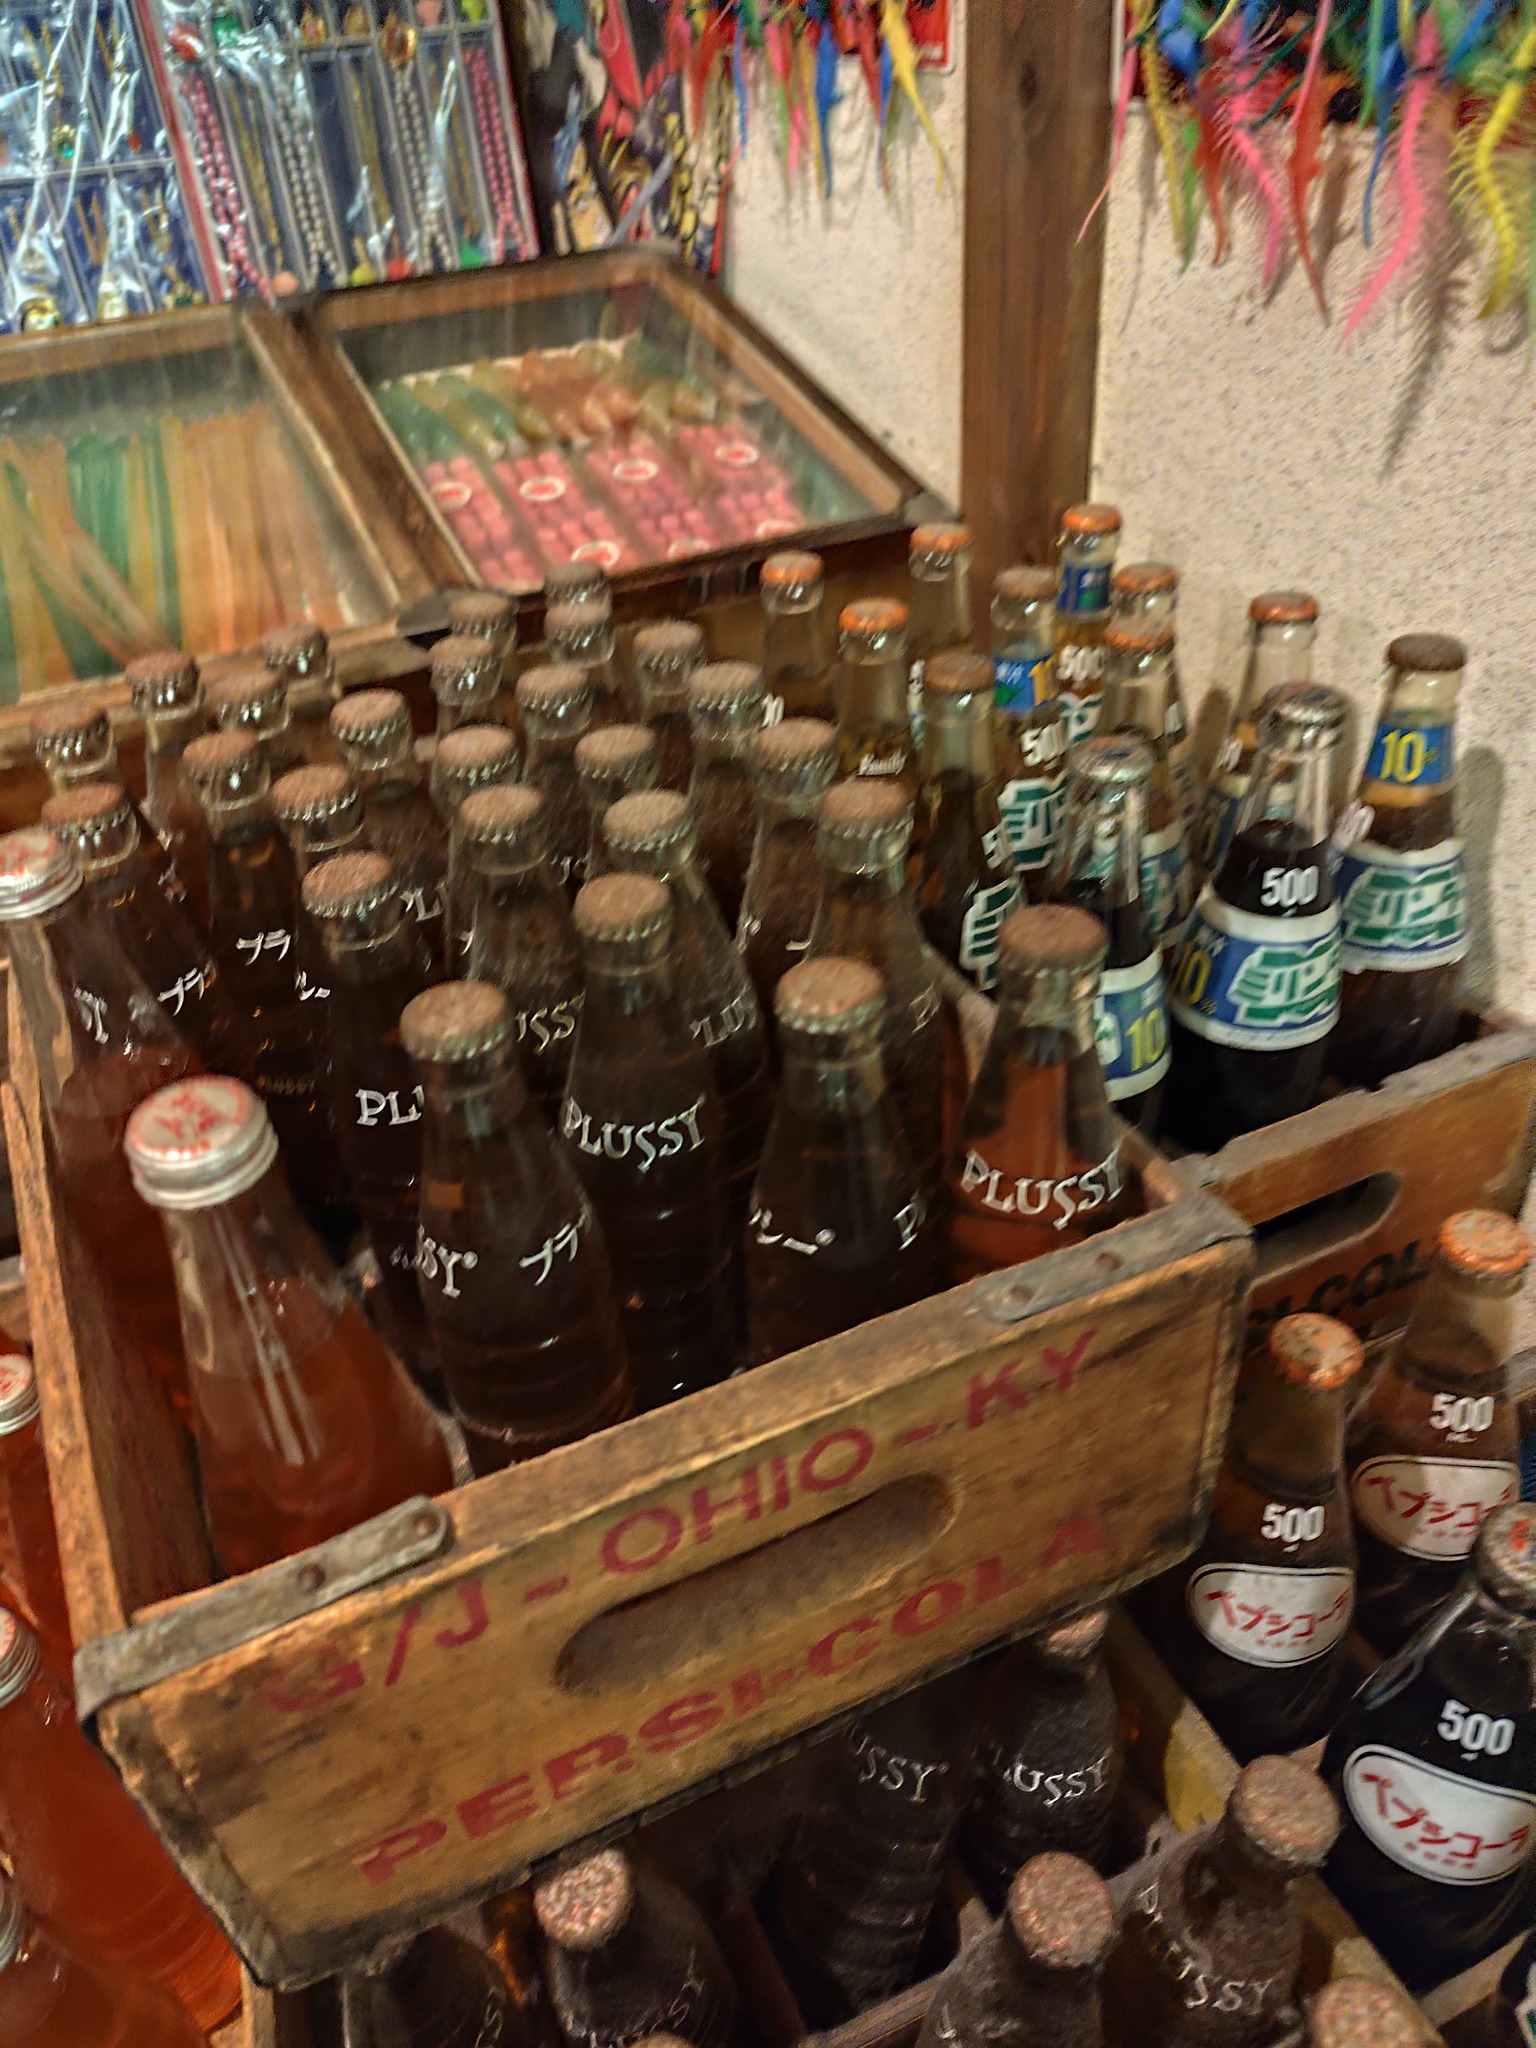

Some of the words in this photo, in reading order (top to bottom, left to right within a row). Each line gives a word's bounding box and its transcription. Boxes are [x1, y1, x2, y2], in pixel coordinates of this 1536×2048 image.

[1261, 865, 1320, 909] 500
[564, 1094, 707, 1174] PLUSSY
[1429, 1392, 1494, 1433] 500
[600, 1427, 874, 1575] OHIO
[964, 1329, 1096, 1431] KY
[1260, 1503, 1325, 1544] 500
[1437, 1698, 1516, 1756] 500
